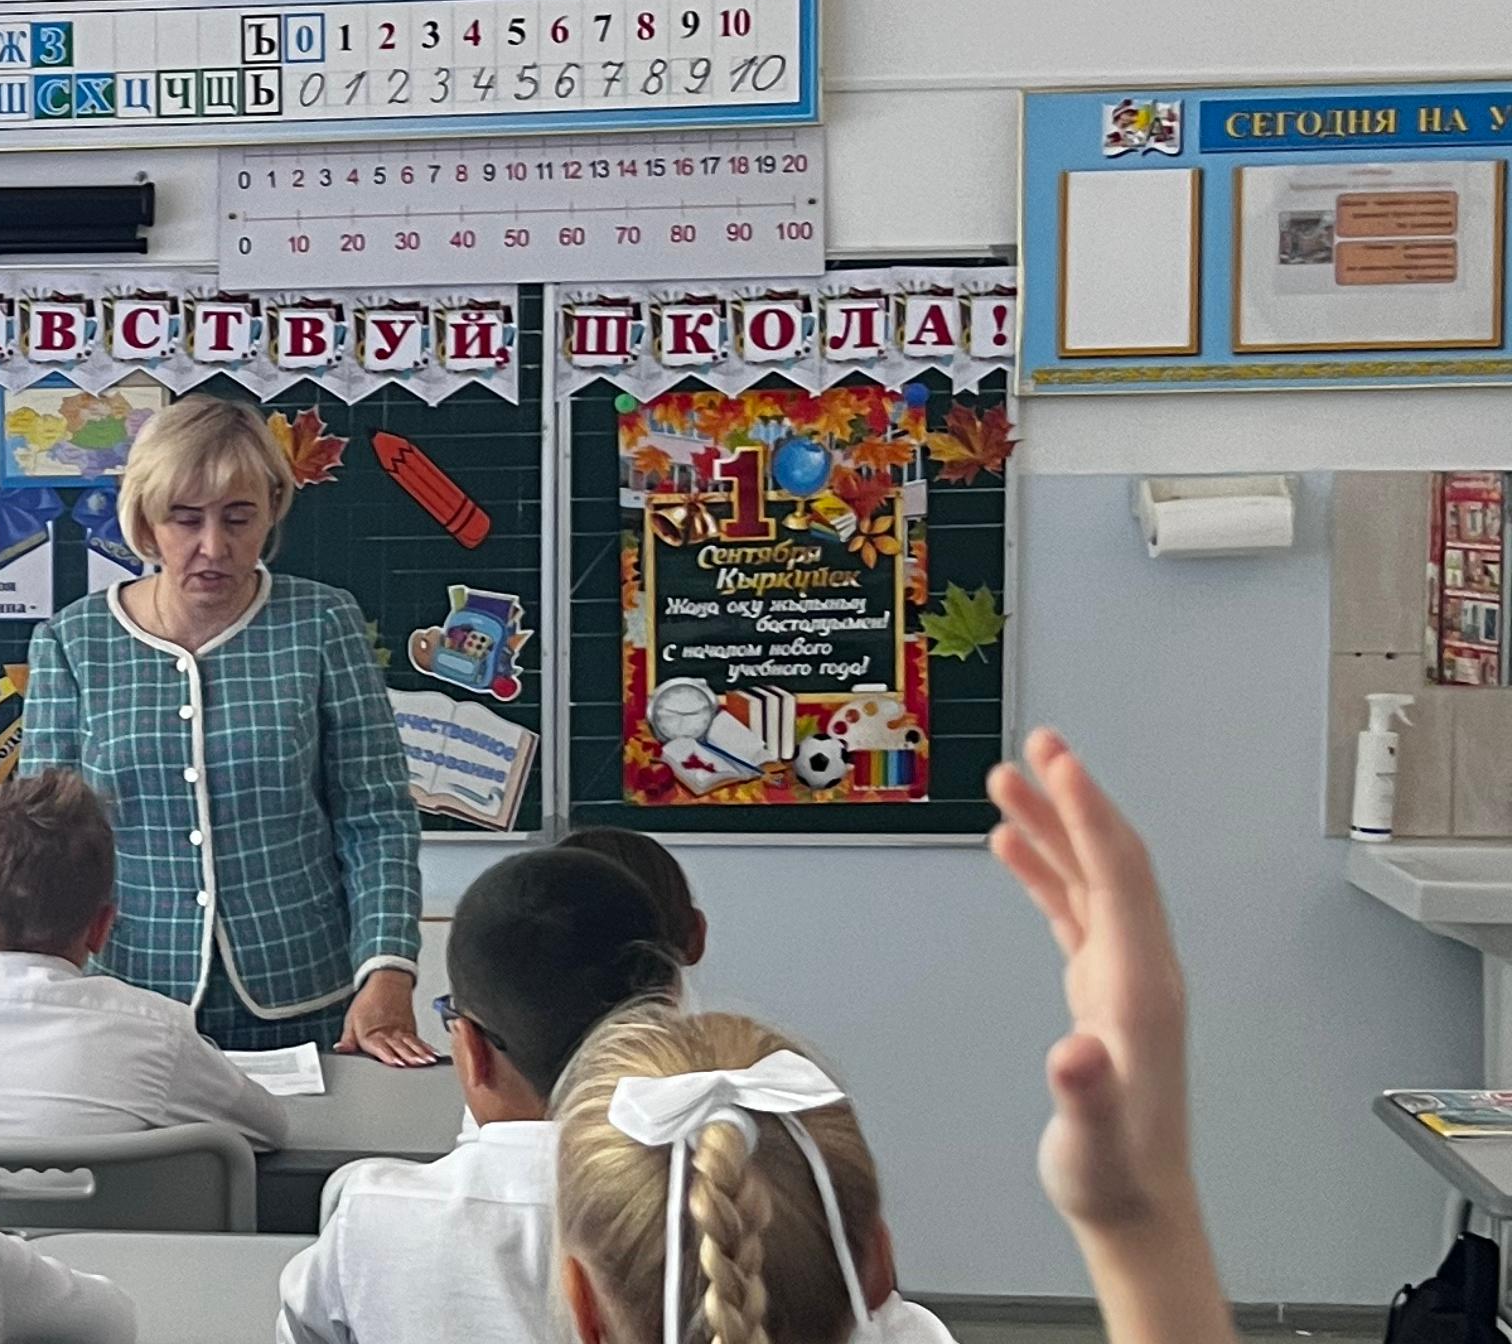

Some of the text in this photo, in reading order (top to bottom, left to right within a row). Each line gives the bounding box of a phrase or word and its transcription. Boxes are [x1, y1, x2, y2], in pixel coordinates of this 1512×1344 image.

[40, 28, 65, 64] З
[249, 24, 275, 55] Ъ
[296, 9, 751, 52] 0 1 2 3 4 5 6 7 8 9 10
[38, 79, 70, 115] С
[77, 77, 113, 113] Х
[125, 79, 151, 111] Ц
[165, 78, 192, 108] Ч
[206, 77, 236, 110] Щ
[251, 74, 274, 105] Ь
[299, 55, 786, 106] 0 1 2 3 4 5 6 7 8 9 10
[1226, 109, 1396, 137] СЕГОДНЯ
[1419, 108, 1468, 132] НА
[238, 155, 807, 188] 0 1 2 3 4 5 6 7 8 9 10 11 12 13 14 15 16 17 18 19 20
[239, 222, 813, 254] 0 10 20 30 40 50 60 70 80 90 100
[714, 445, 776, 541] 1
[663, 637, 832, 661] С началом нового
[726, 656, 871, 682] учебного года!
